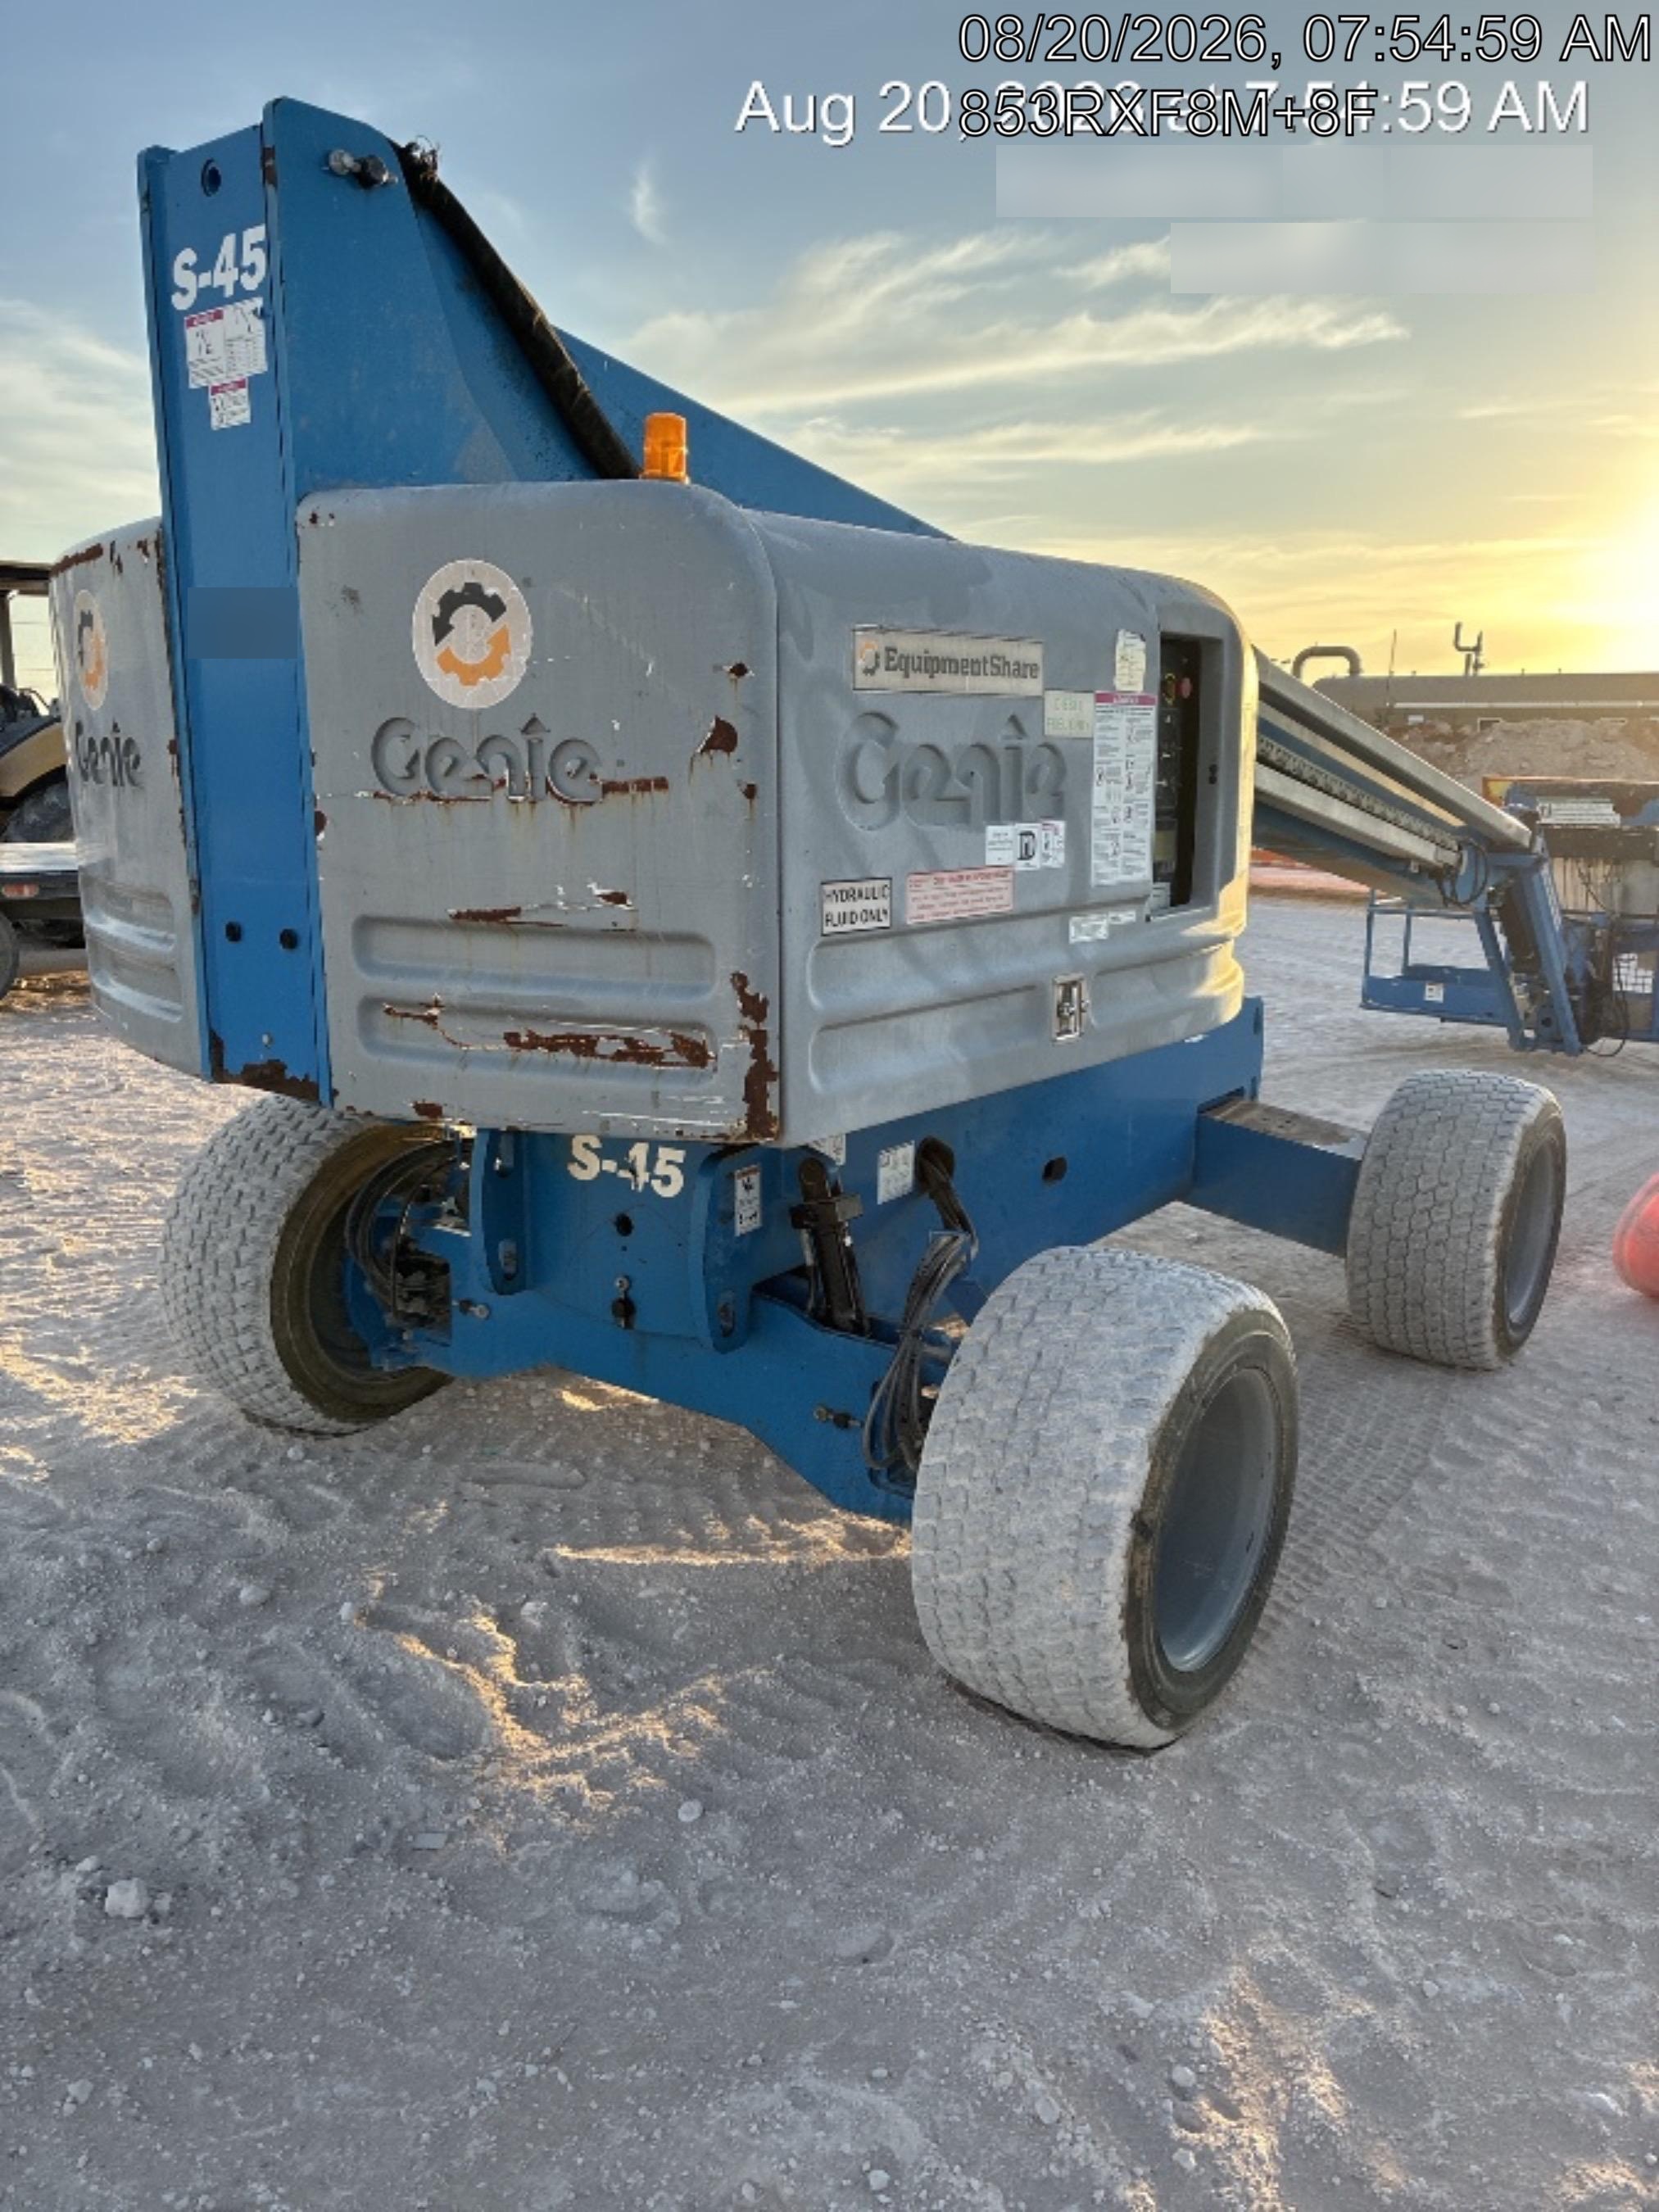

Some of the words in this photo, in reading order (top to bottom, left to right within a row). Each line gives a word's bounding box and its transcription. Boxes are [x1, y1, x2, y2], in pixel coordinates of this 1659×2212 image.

[170, 223, 268, 310] S-45
[884, 646, 1040, 679] EquipmentShare
[75, 719, 145, 789] Genie
[370, 713, 602, 805] Genie
[835, 714, 1066, 832] Genie
